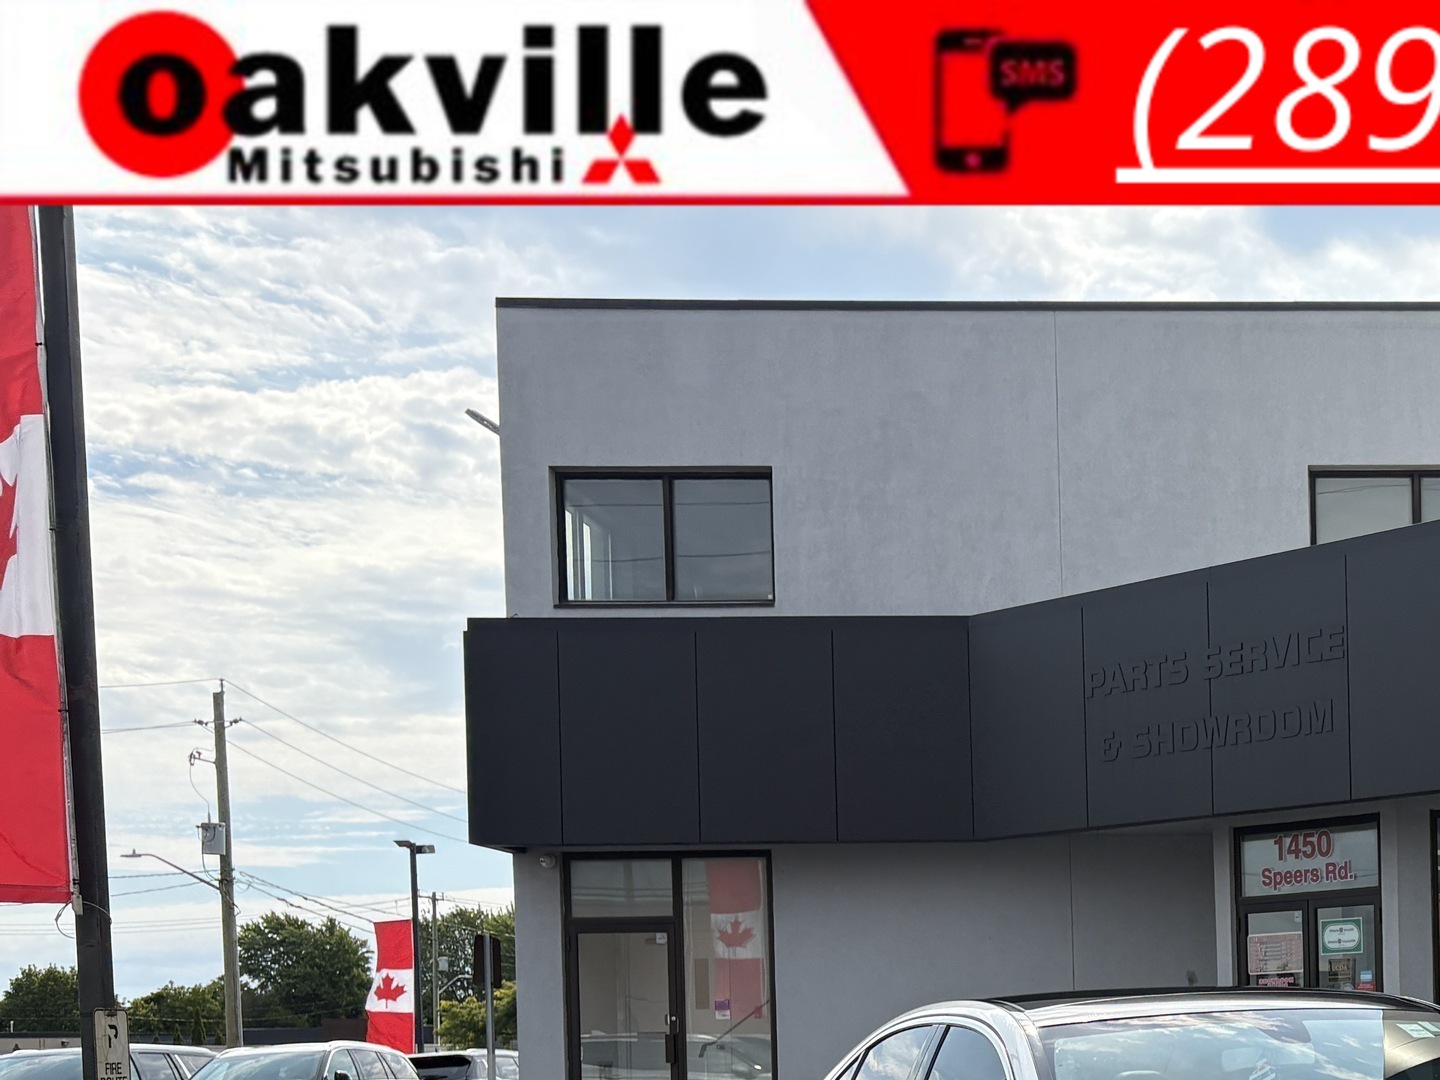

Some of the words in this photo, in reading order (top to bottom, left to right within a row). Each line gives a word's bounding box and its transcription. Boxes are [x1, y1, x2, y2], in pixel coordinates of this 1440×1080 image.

[1086, 652, 1189, 699] PARTS
[1203, 625, 1345, 680] SERVICE
[1132, 698, 1335, 760] SHOWROOM
[1273, 829, 1333, 862] 1450
[1261, 867, 1321, 892] Speers
[1325, 860, 1355, 882] Rd.
[105, 1062, 122, 1075] FIRE
